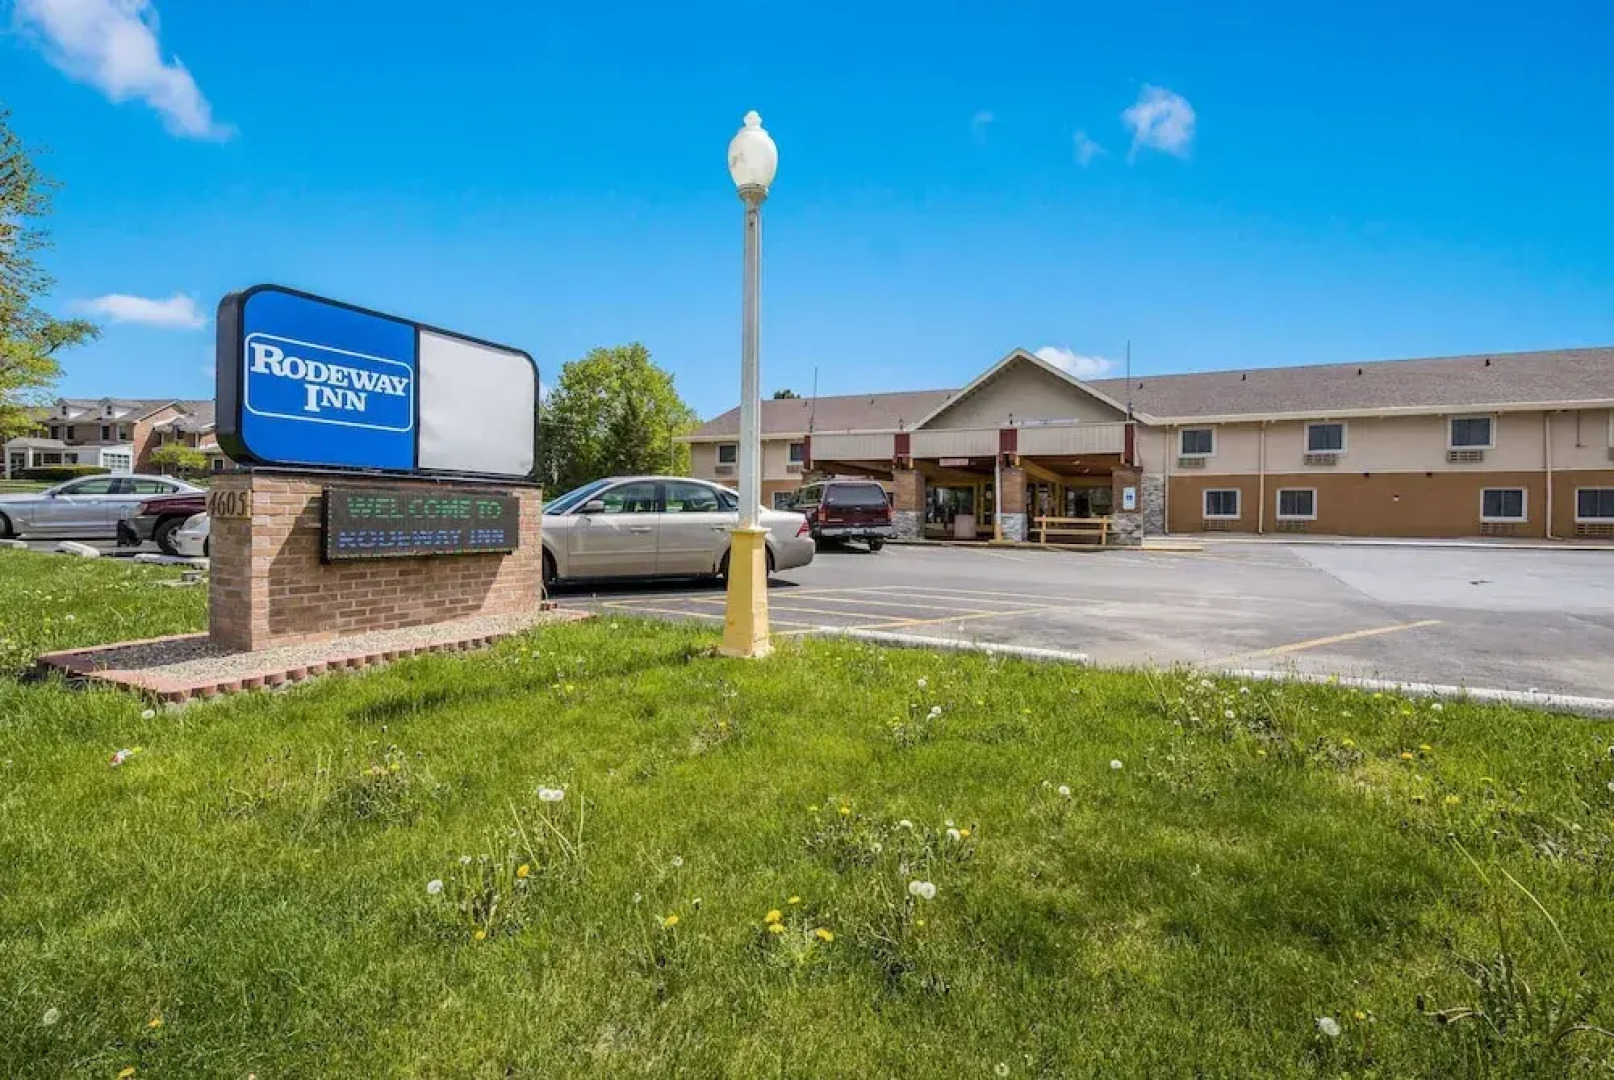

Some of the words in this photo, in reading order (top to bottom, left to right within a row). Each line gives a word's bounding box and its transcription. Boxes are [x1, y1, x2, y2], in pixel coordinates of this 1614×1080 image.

[208, 491, 247, 516] 4605
[347, 498, 471, 518] WELCOME
[476, 501, 502, 518] TO
